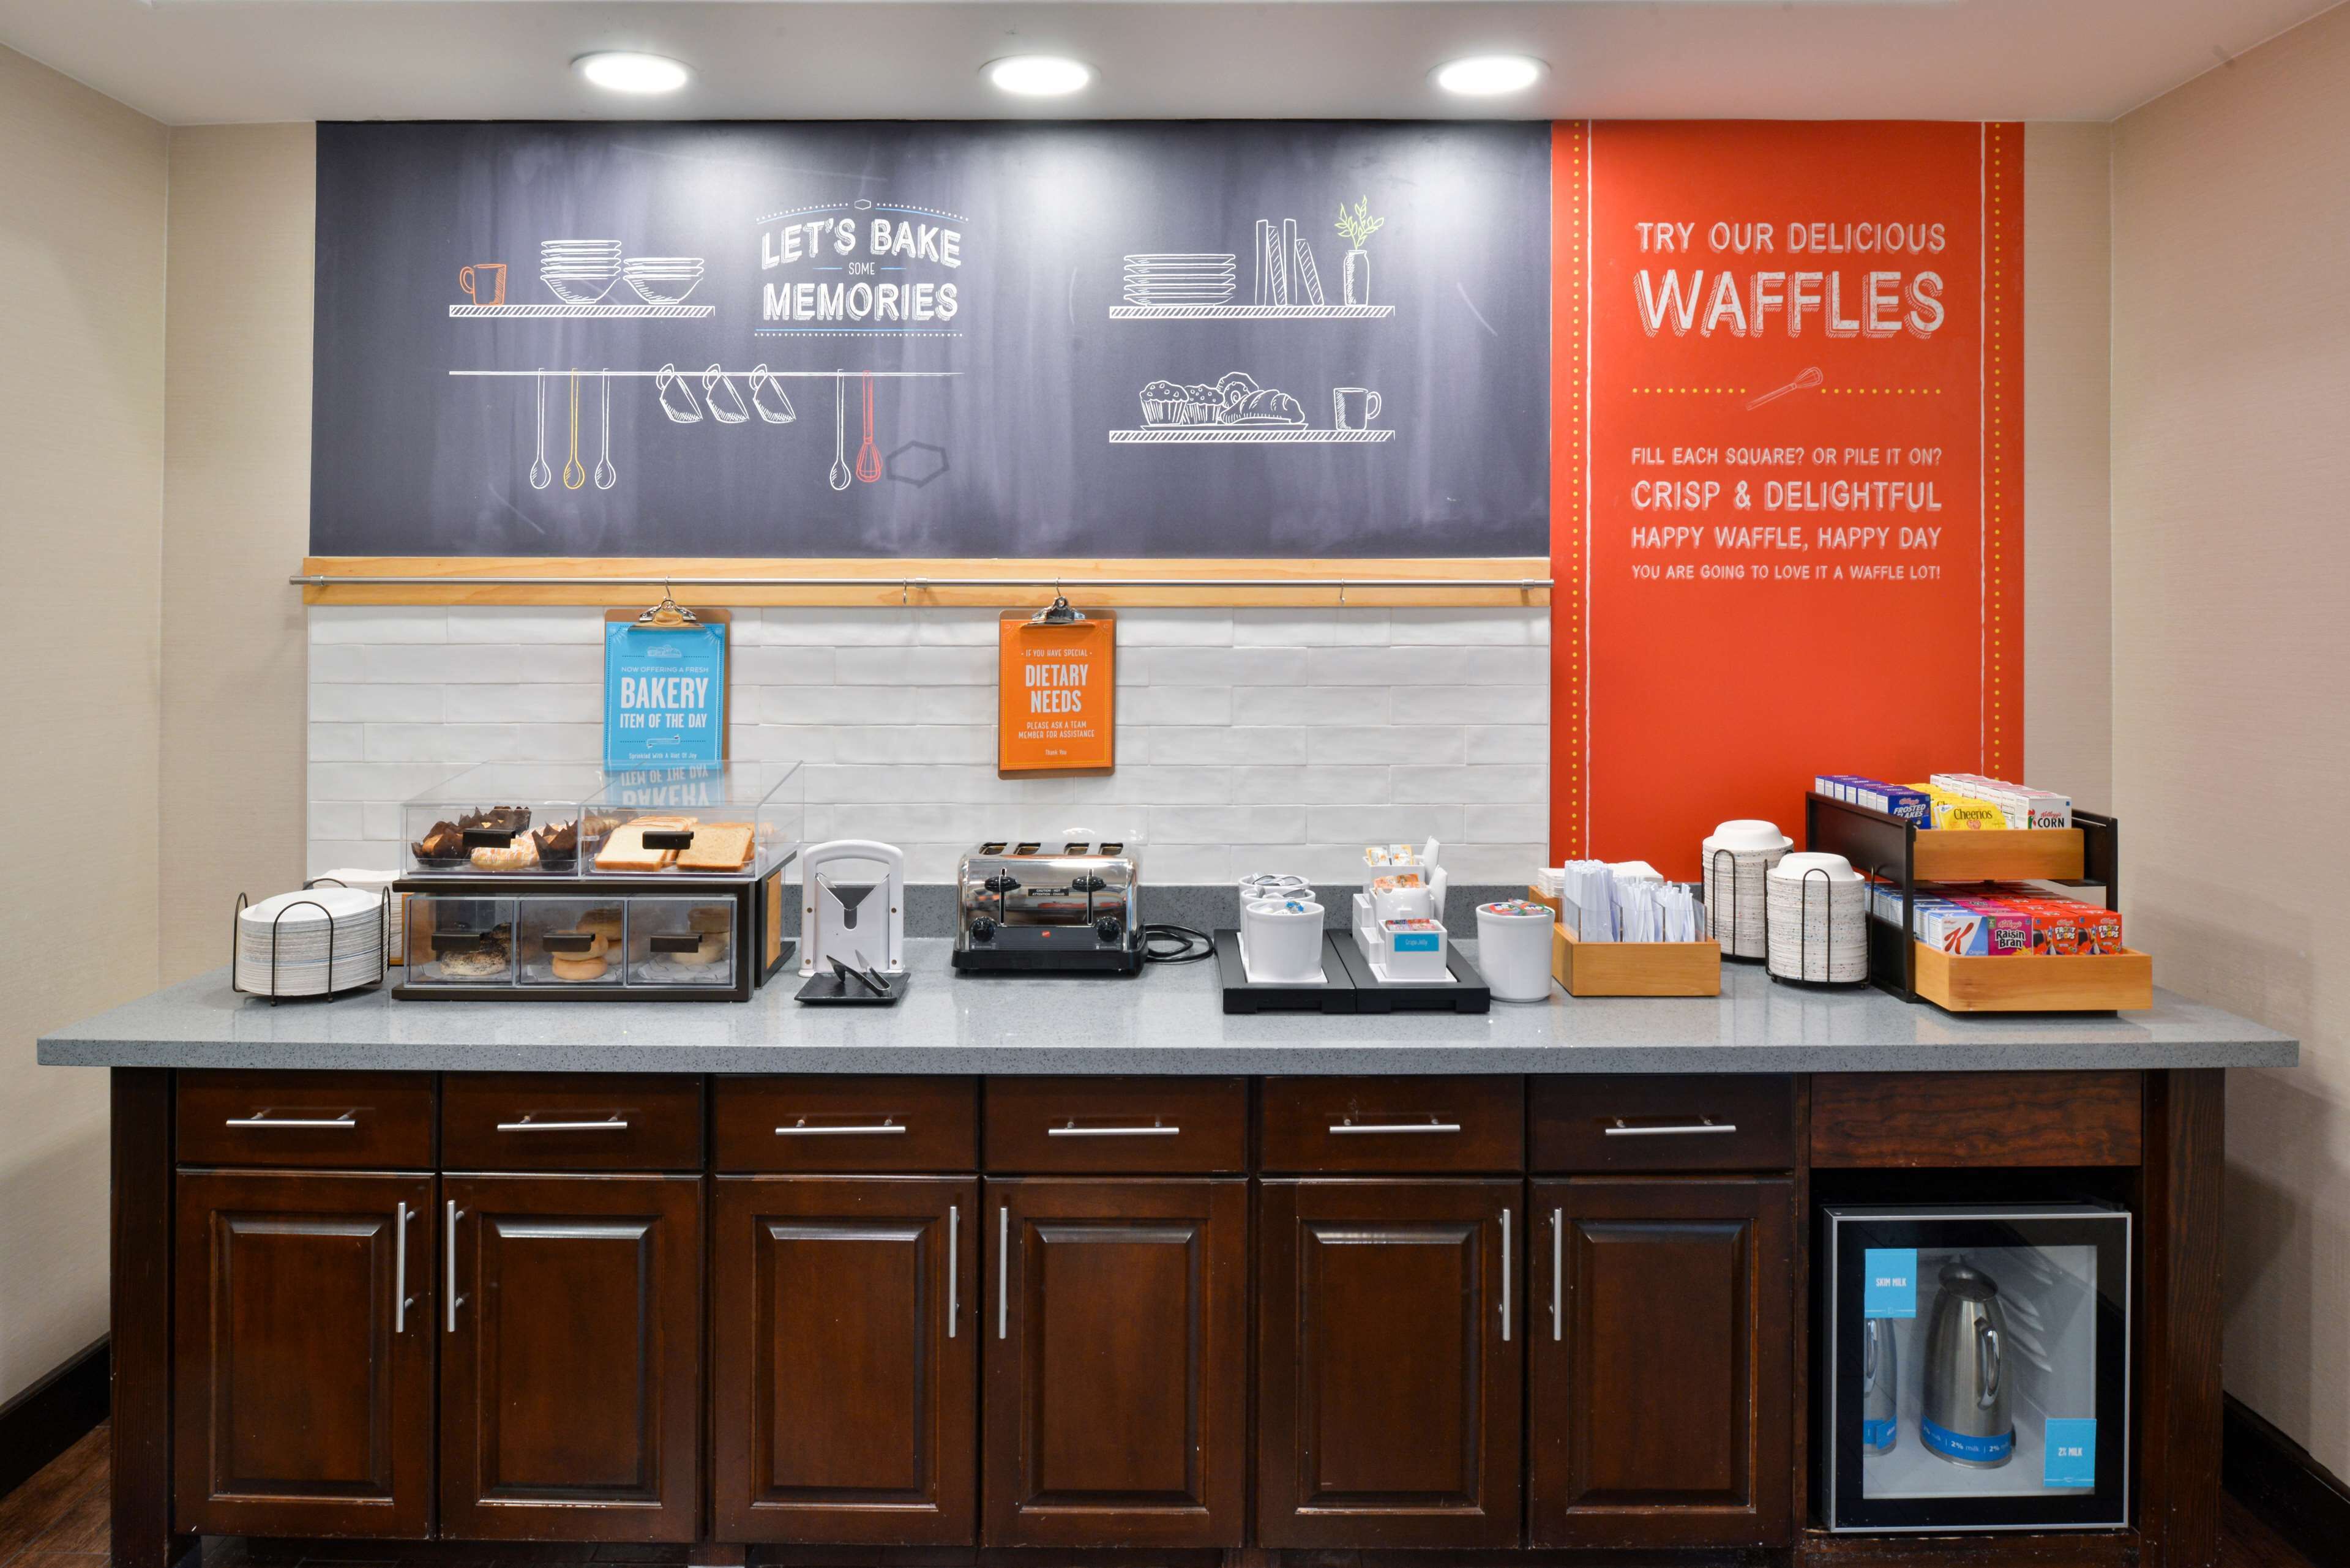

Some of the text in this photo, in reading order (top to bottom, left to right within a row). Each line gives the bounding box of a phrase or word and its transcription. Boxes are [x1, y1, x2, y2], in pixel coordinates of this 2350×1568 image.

[762, 218, 961, 269] LET'S BAKE
[1635, 222, 1945, 254] TRY OUR DELICIOUS
[848, 263, 875, 275] SOME
[763, 282, 958, 321] MEMORIES
[1633, 270, 1944, 339] WAFFLES
[1632, 447, 1942, 466] FILL EACH SQUARE? OR PILE IT ON?
[1631, 480, 1941, 511] CRISP & DELIGHTFUL
[1632, 526, 1941, 551] HAPPY WAFFLE, HAPPY DAY
[1632, 565, 1940, 579] YOU ARE GOING TO LOVE IT A WAFFLE LOT!
[1025, 664, 1088, 687] DIETARY
[621, 677, 708, 709] BAKERY
[1031, 690, 1082, 713] NEEDS
[620, 713, 707, 728] ITEM OF THE DAY
[1894, 804, 1926, 815] FROSTED
[1954, 808, 1993, 820] Cheerios
[2038, 818, 2064, 827] CORN
[1996, 928, 2026, 942] Raisin
[1999, 939, 2023, 949] Bran
[1876, 1278, 1906, 1286] SKIM MILK
[1951, 1441, 1964, 1450] 2%
[2058, 1447, 2082, 1456] 2% MILK
